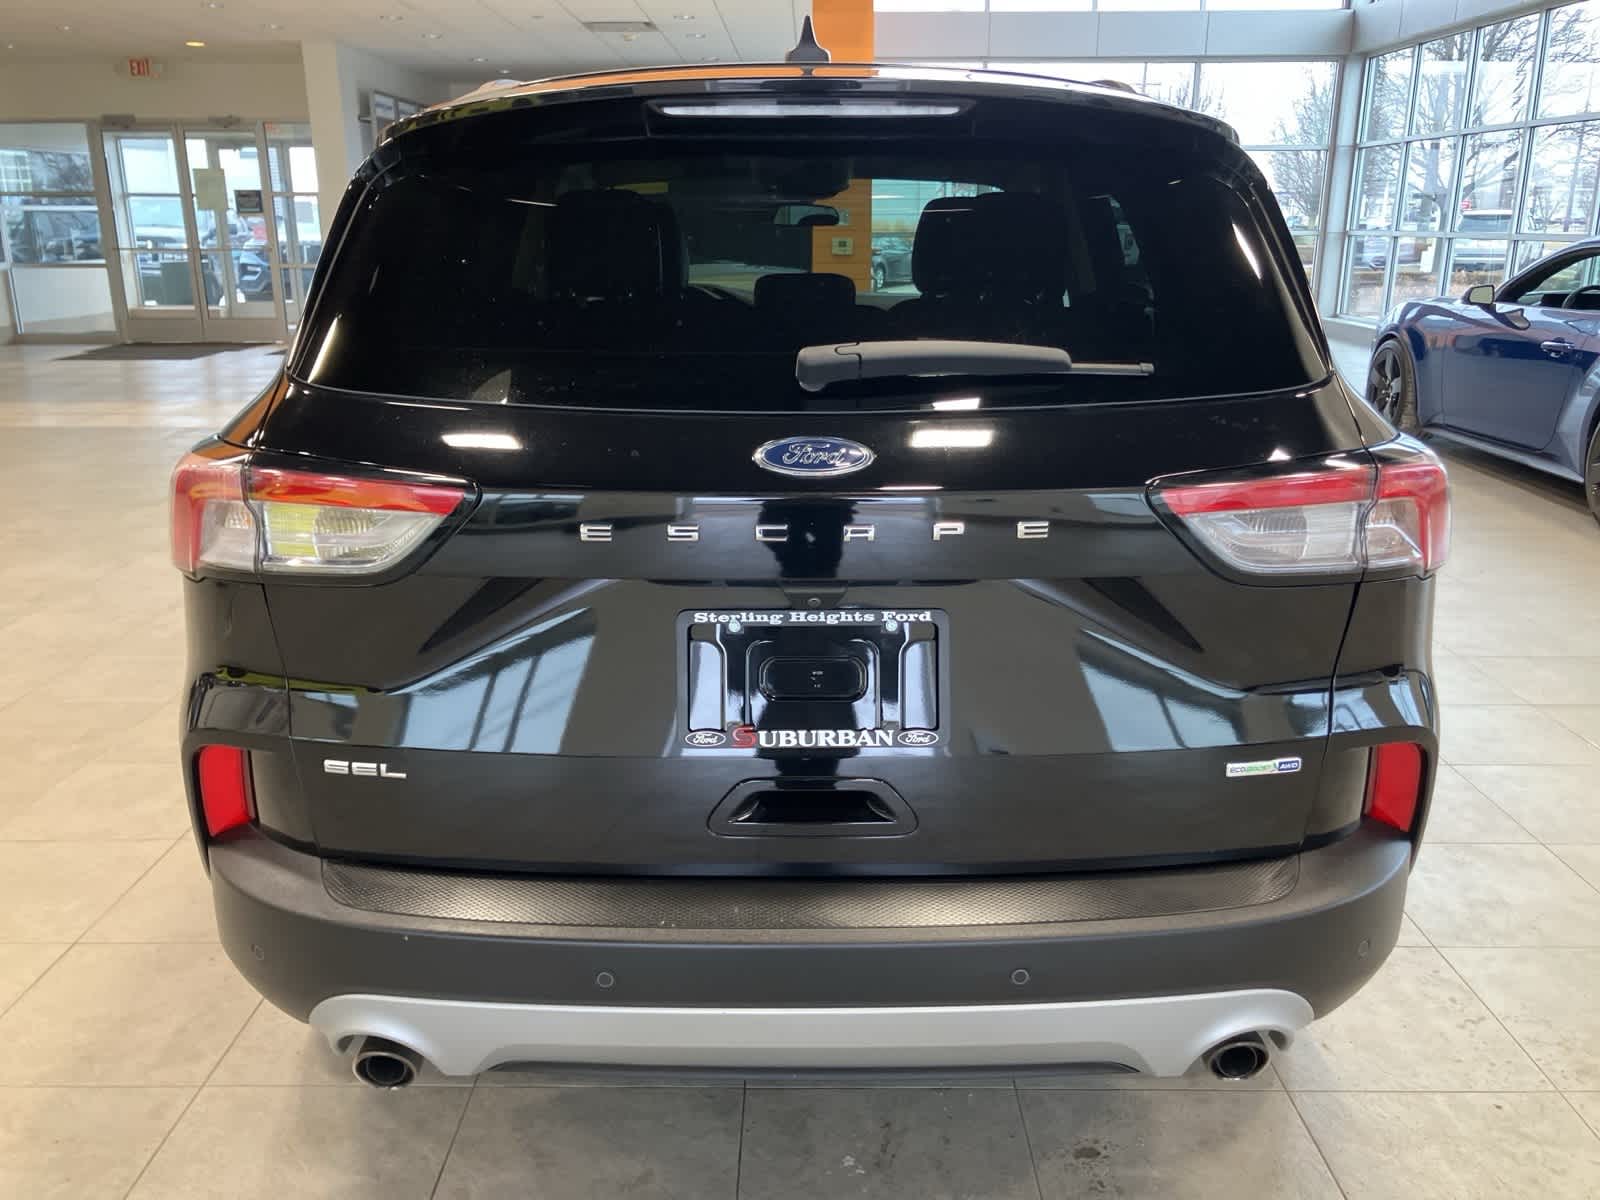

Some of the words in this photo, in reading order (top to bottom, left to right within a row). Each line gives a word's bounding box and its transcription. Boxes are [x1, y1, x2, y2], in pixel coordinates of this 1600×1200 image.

[580, 521, 1048, 542] ESCAPE
[693, 612, 784, 625] Sterling
[789, 611, 875, 624] Heights
[881, 611, 932, 622] Ford
[731, 725, 894, 748] SUBURBAN
[323, 759, 407, 779] SEL
